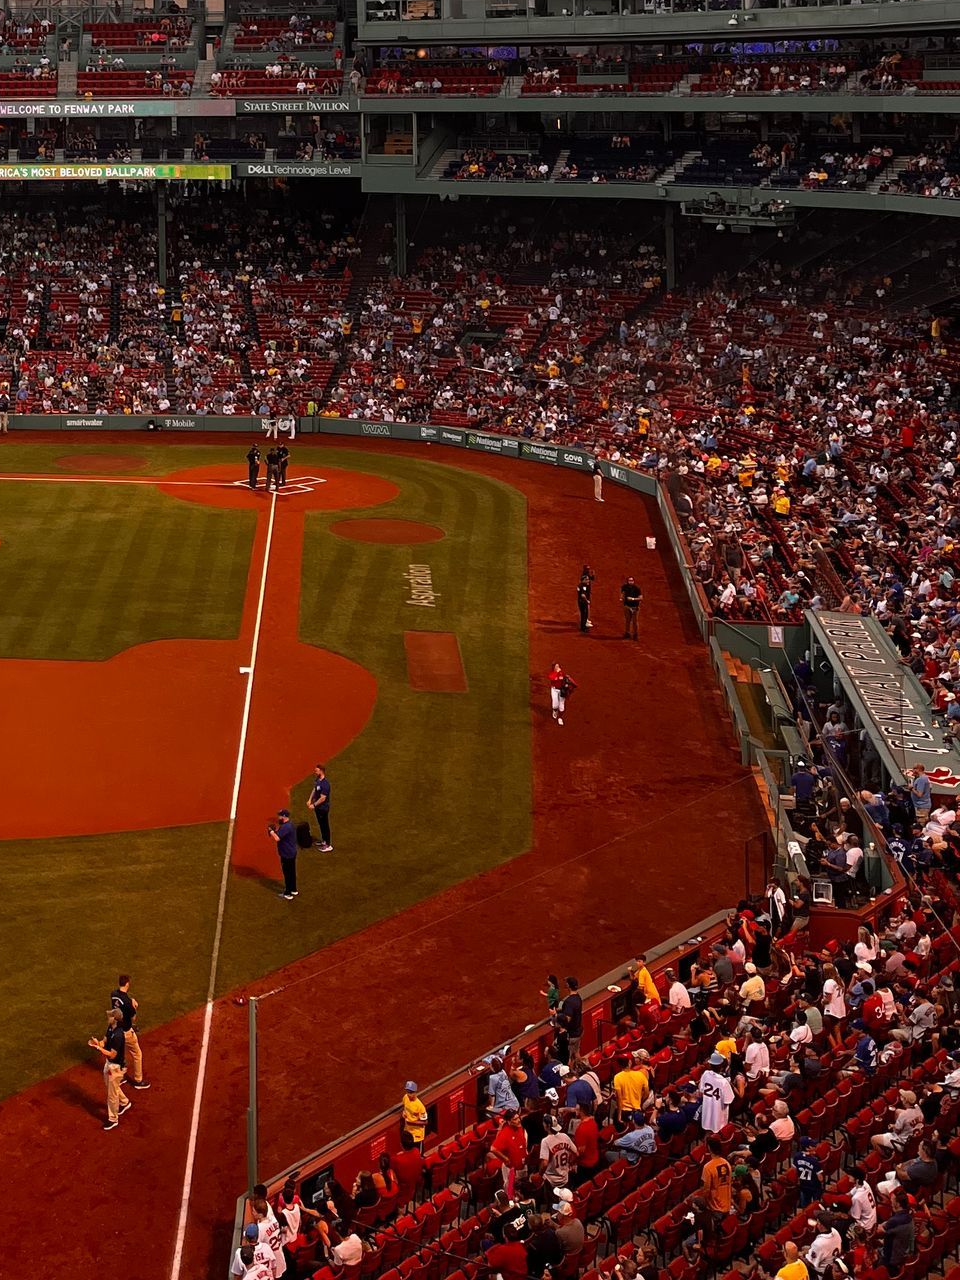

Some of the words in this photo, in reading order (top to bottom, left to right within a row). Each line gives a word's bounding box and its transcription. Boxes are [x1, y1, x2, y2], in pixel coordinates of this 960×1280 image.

[0, 105, 46, 114] WELCOME
[49, 105, 62, 114] TO
[65, 105, 105, 114] FENWAY
[108, 104, 135, 113] PARK
[244, 102, 270, 111] STATE
[271, 102, 304, 111] STREET
[306, 102, 350, 111] PAVILION
[31, 167, 56, 177] MOST
[60, 167, 103, 177] BELOVED
[106, 167, 156, 177] BALLPARK
[248, 165, 274, 174] DELL
[274, 165, 328, 176] Technologies
[329, 166, 352, 174] Level
[172, 419, 196, 427] Mobile
[362, 424, 390, 435] WM
[476, 437, 502, 448] National
[530, 446, 558, 458] National
[563, 453, 583, 463] GOYA
[402, 564, 441, 607] Aspiration
[819, 616, 886, 665] PARK
[847, 665, 950, 755] FENWAY
[703, 1083, 721, 1100] 24
[555, 1152, 568, 1168] 18
[798, 1167, 812, 1181] 27
